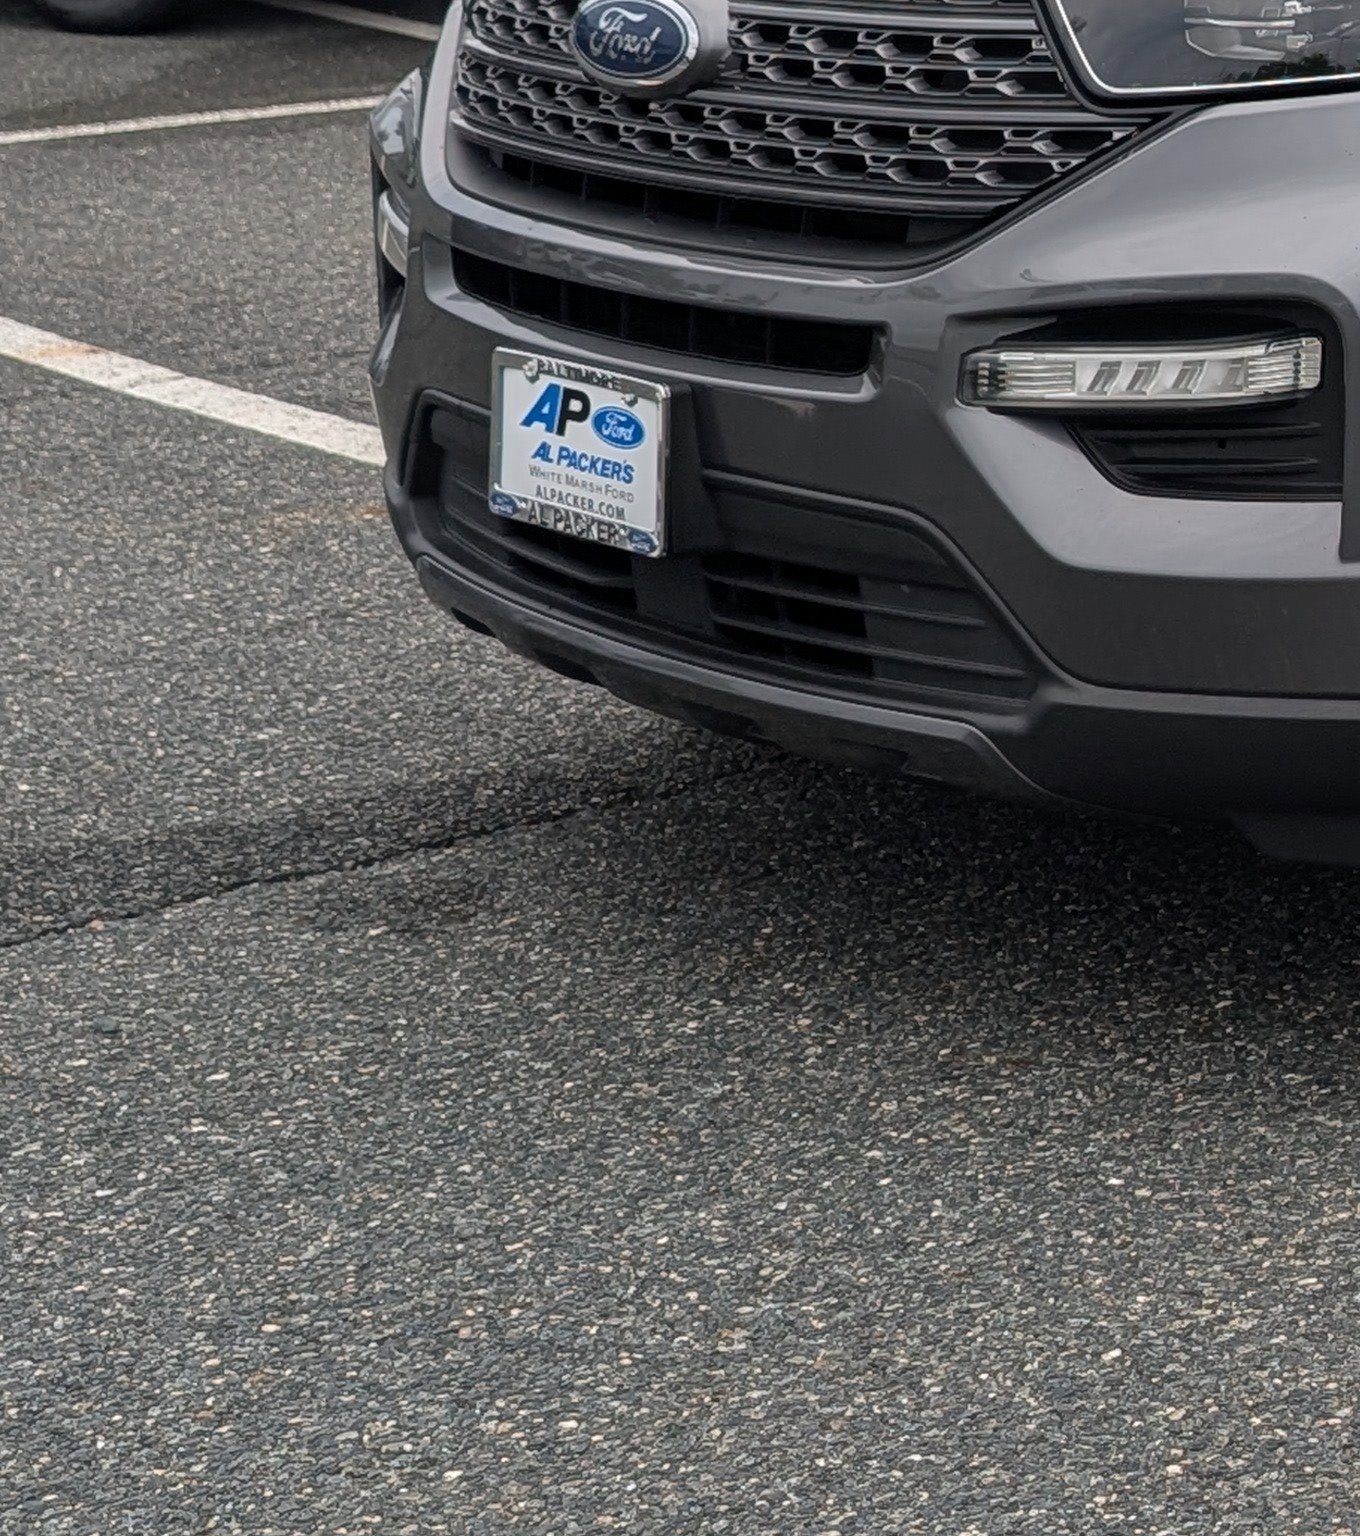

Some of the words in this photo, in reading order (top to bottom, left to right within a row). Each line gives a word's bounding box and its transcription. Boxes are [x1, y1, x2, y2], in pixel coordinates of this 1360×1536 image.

[589, 6, 664, 63] Ford
[519, 382, 591, 437] AP
[601, 411, 636, 442] Ford
[531, 441, 554, 464] AL
[557, 445, 635, 484] PACKER'S
[528, 500, 550, 526] AL
[535, 484, 627, 521] ALPACKER.COM
